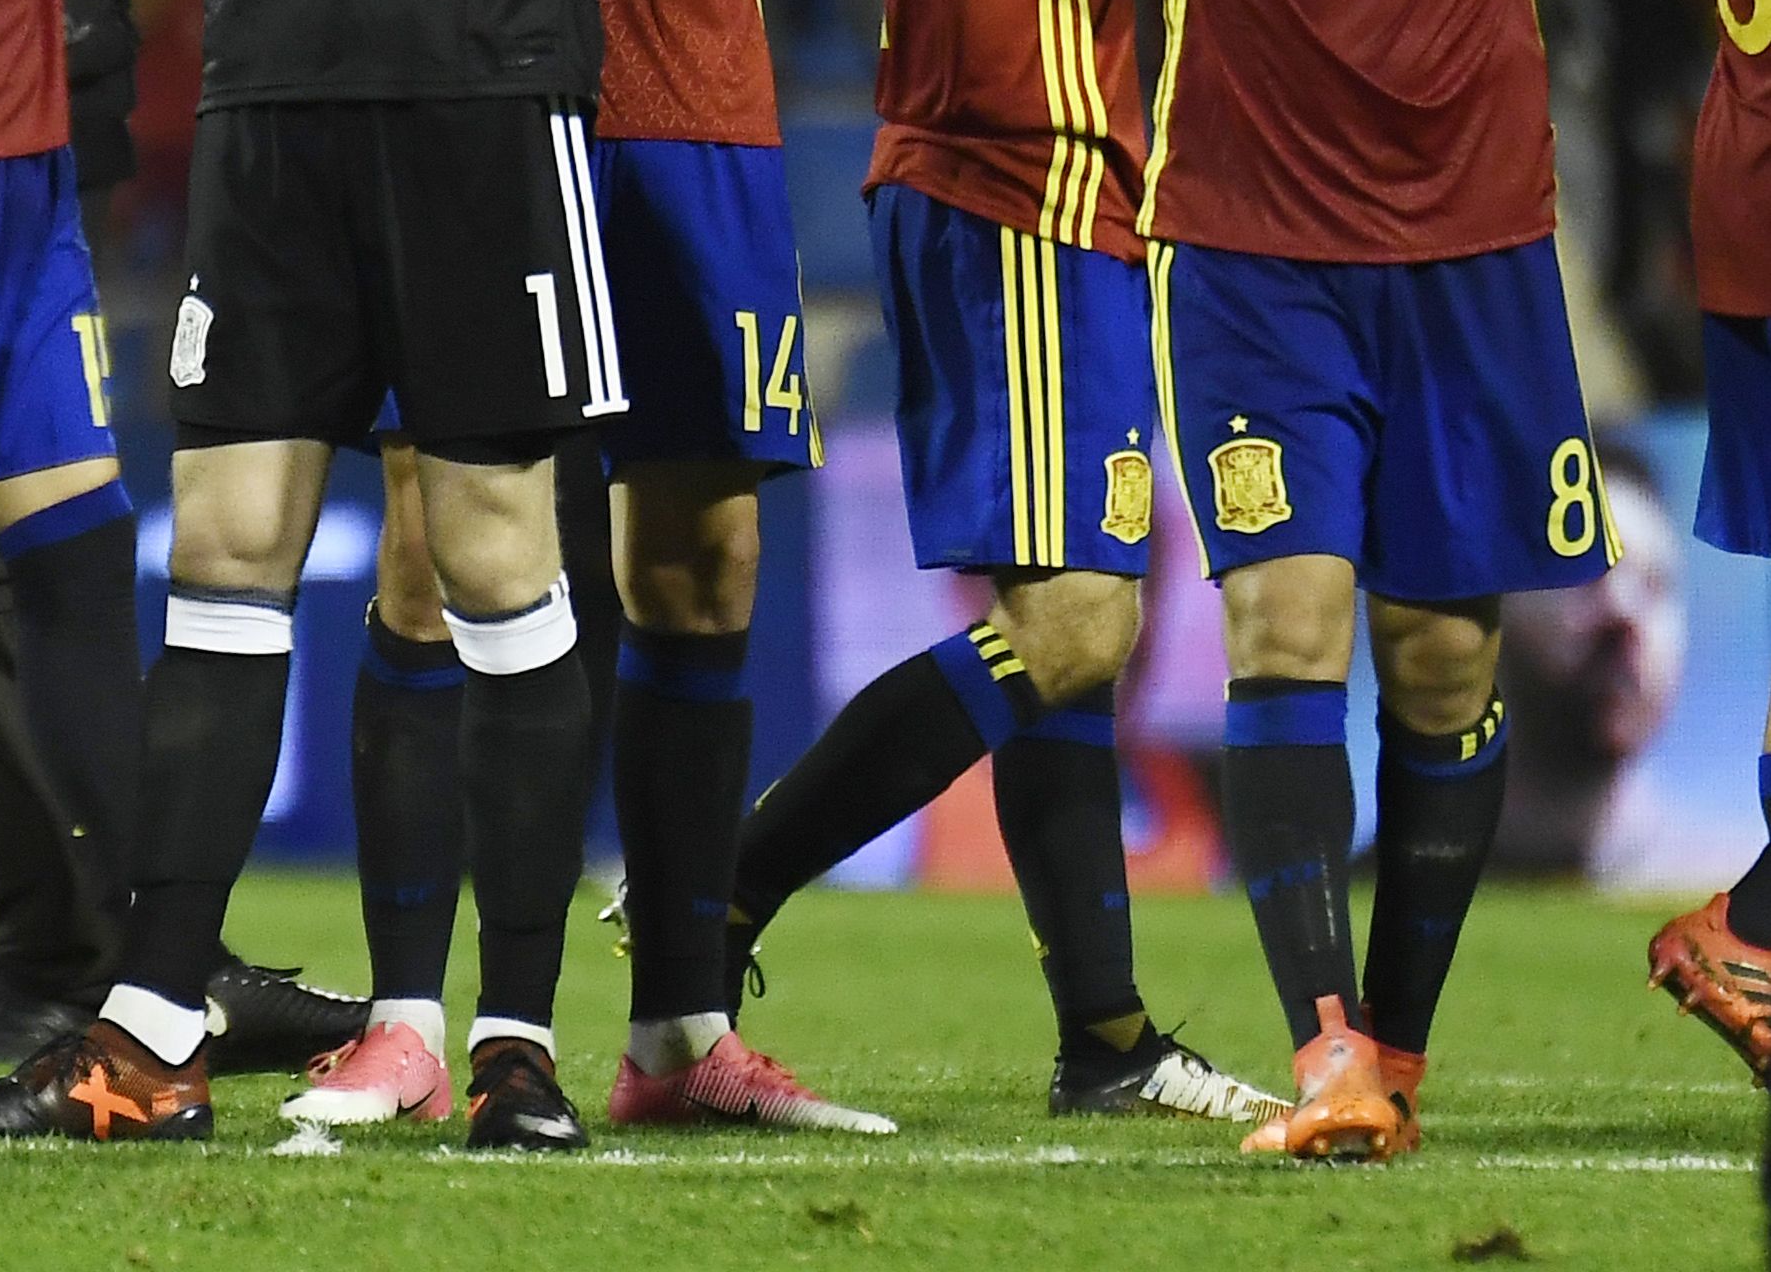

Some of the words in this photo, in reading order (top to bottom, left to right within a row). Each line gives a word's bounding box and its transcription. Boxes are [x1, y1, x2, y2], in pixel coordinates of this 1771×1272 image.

[525, 272, 568, 398] 1
[735, 311, 802, 436] 14
[1547, 437, 1595, 557] 8
